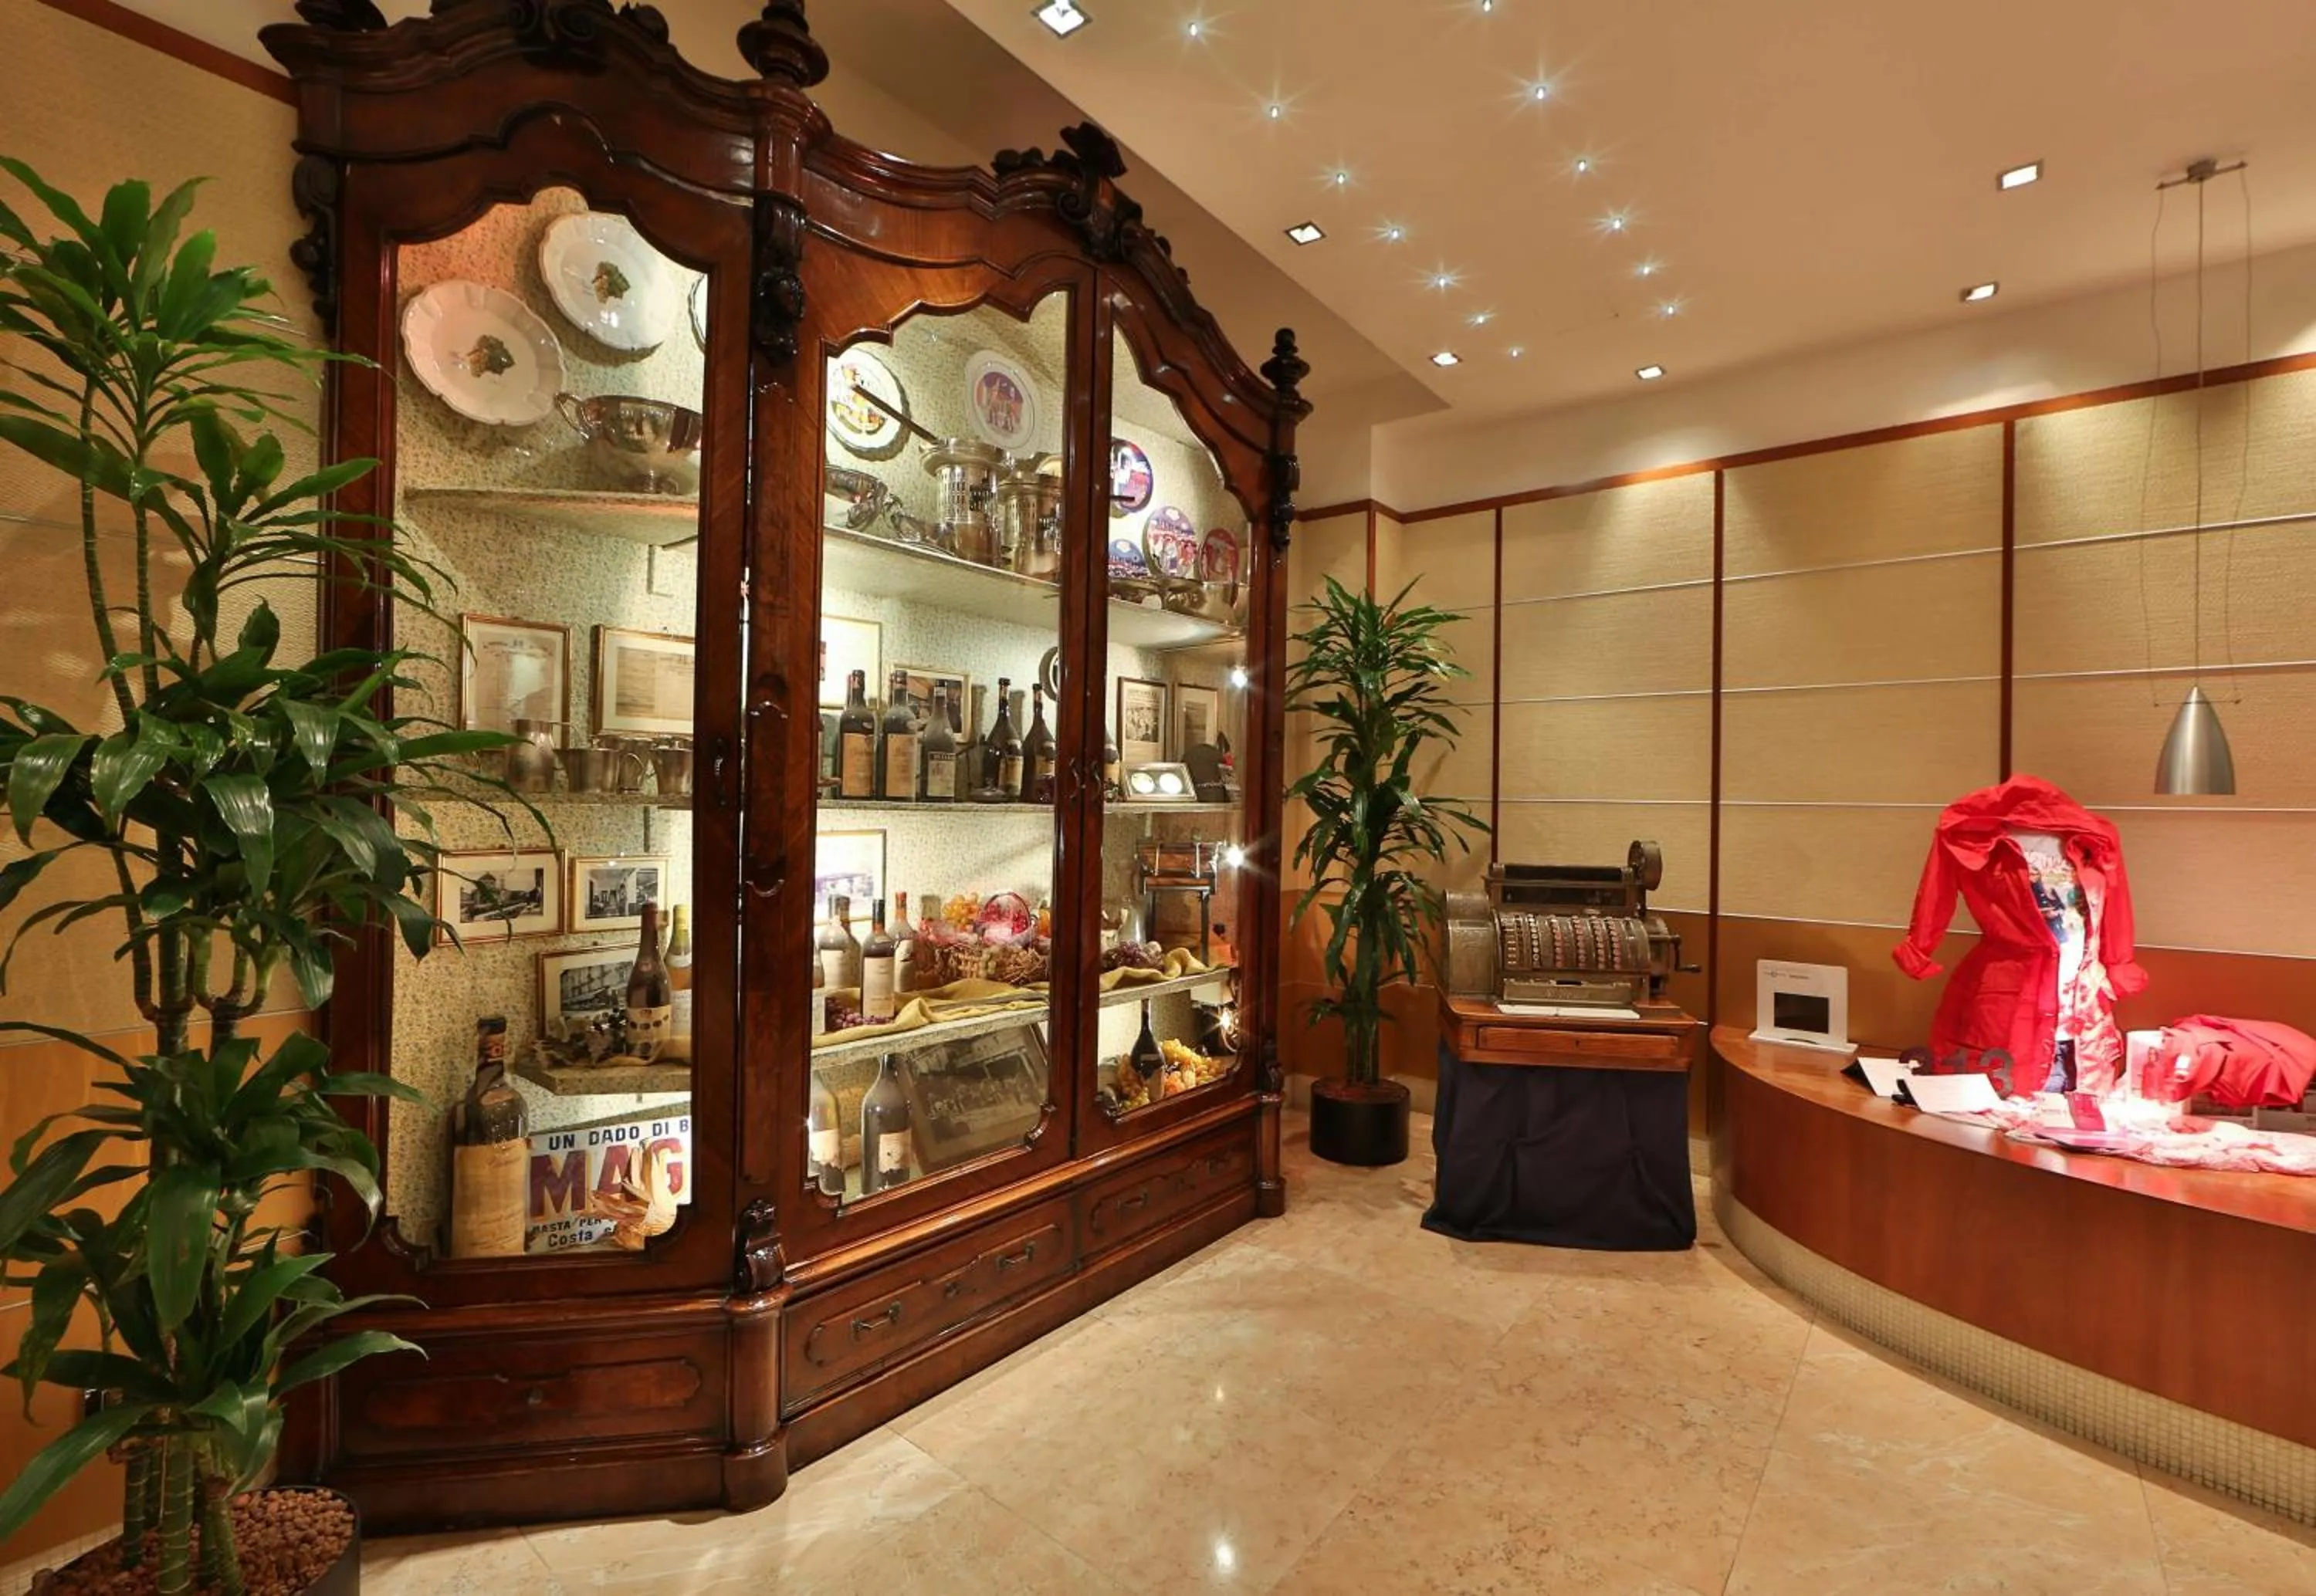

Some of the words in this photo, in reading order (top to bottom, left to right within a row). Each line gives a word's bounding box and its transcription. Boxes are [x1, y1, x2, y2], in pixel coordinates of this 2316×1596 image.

[549, 1134, 575, 1151] UN
[589, 1126, 640, 1145] DADO
[652, 1121, 669, 1137] DI
[530, 1138, 683, 1218] MAG
[547, 1230, 593, 1247] Costa
